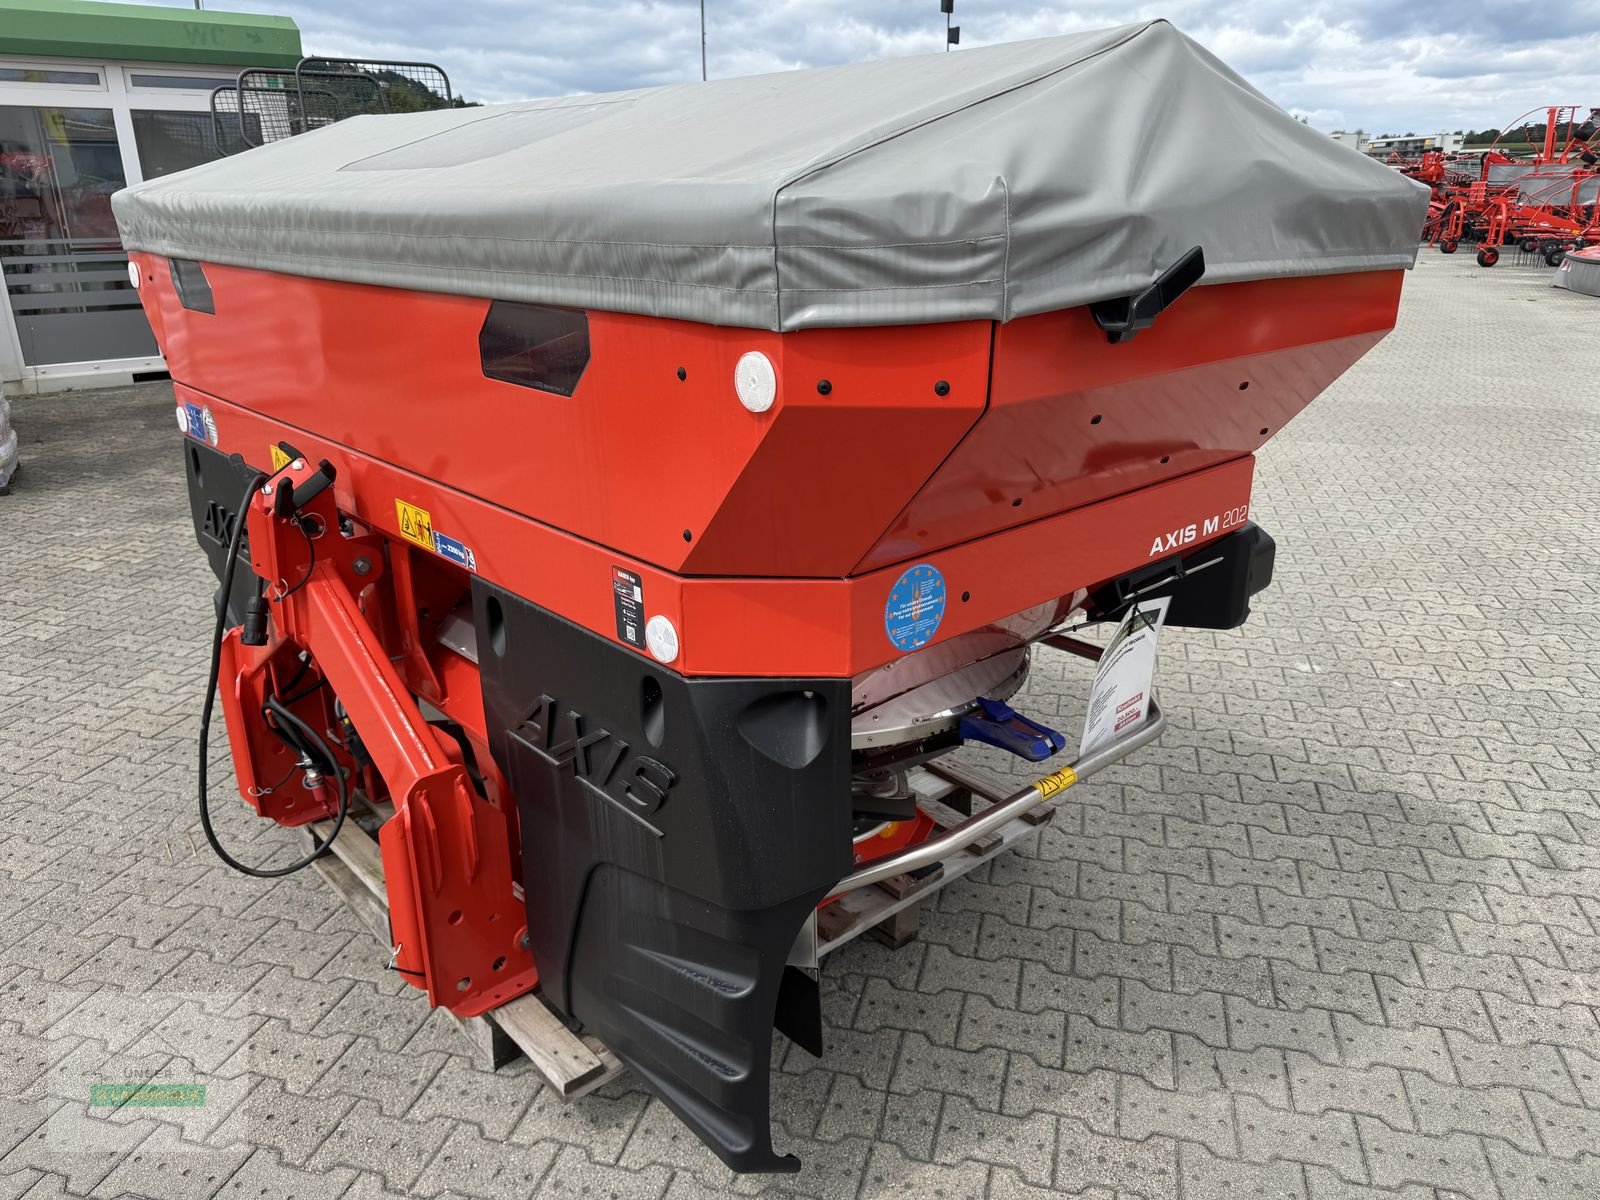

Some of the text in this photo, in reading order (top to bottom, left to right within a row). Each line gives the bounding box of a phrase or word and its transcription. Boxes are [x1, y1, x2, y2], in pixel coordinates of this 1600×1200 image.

[182, 23, 225, 46] WC
[1149, 523, 1197, 556] AXIS
[1202, 515, 1220, 537] M
[505, 692, 676, 818] AXIS
